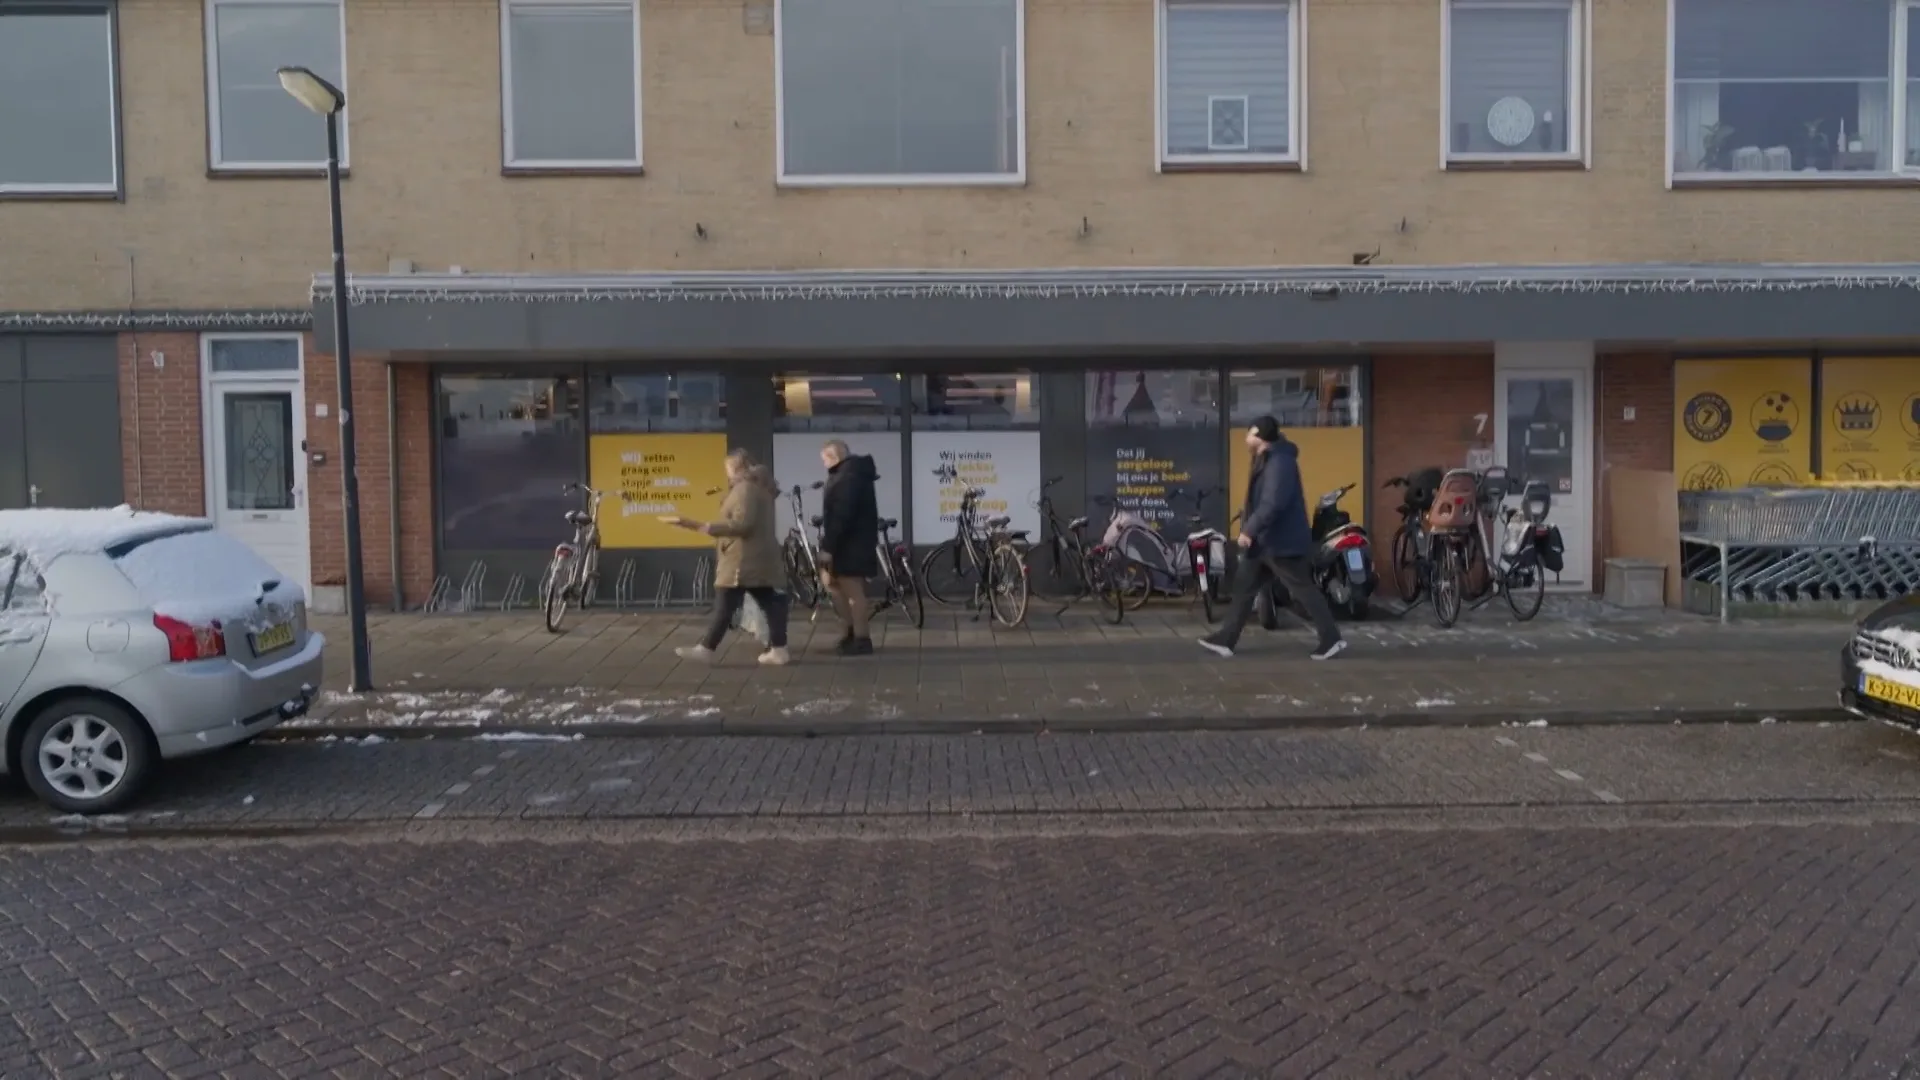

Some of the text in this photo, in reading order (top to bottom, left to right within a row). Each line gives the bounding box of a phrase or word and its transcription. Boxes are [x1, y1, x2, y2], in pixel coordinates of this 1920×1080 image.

[1702, 409, 1715, 425] 7
[1473, 412, 1489, 435] 7
[939, 450, 992, 462] Wij vinden
[1116, 447, 1145, 460] Dat jij
[621, 465, 670, 476] graag een
[1116, 471, 1129, 485] bij
[1130, 473, 1148, 482] ons
[1149, 471, 1159, 484] je
[651, 491, 671, 500] met
[673, 492, 692, 500] een
[1141, 496, 1169, 508] doen,
[1143, 509, 1156, 521] bij
[1157, 511, 1175, 520] ons
